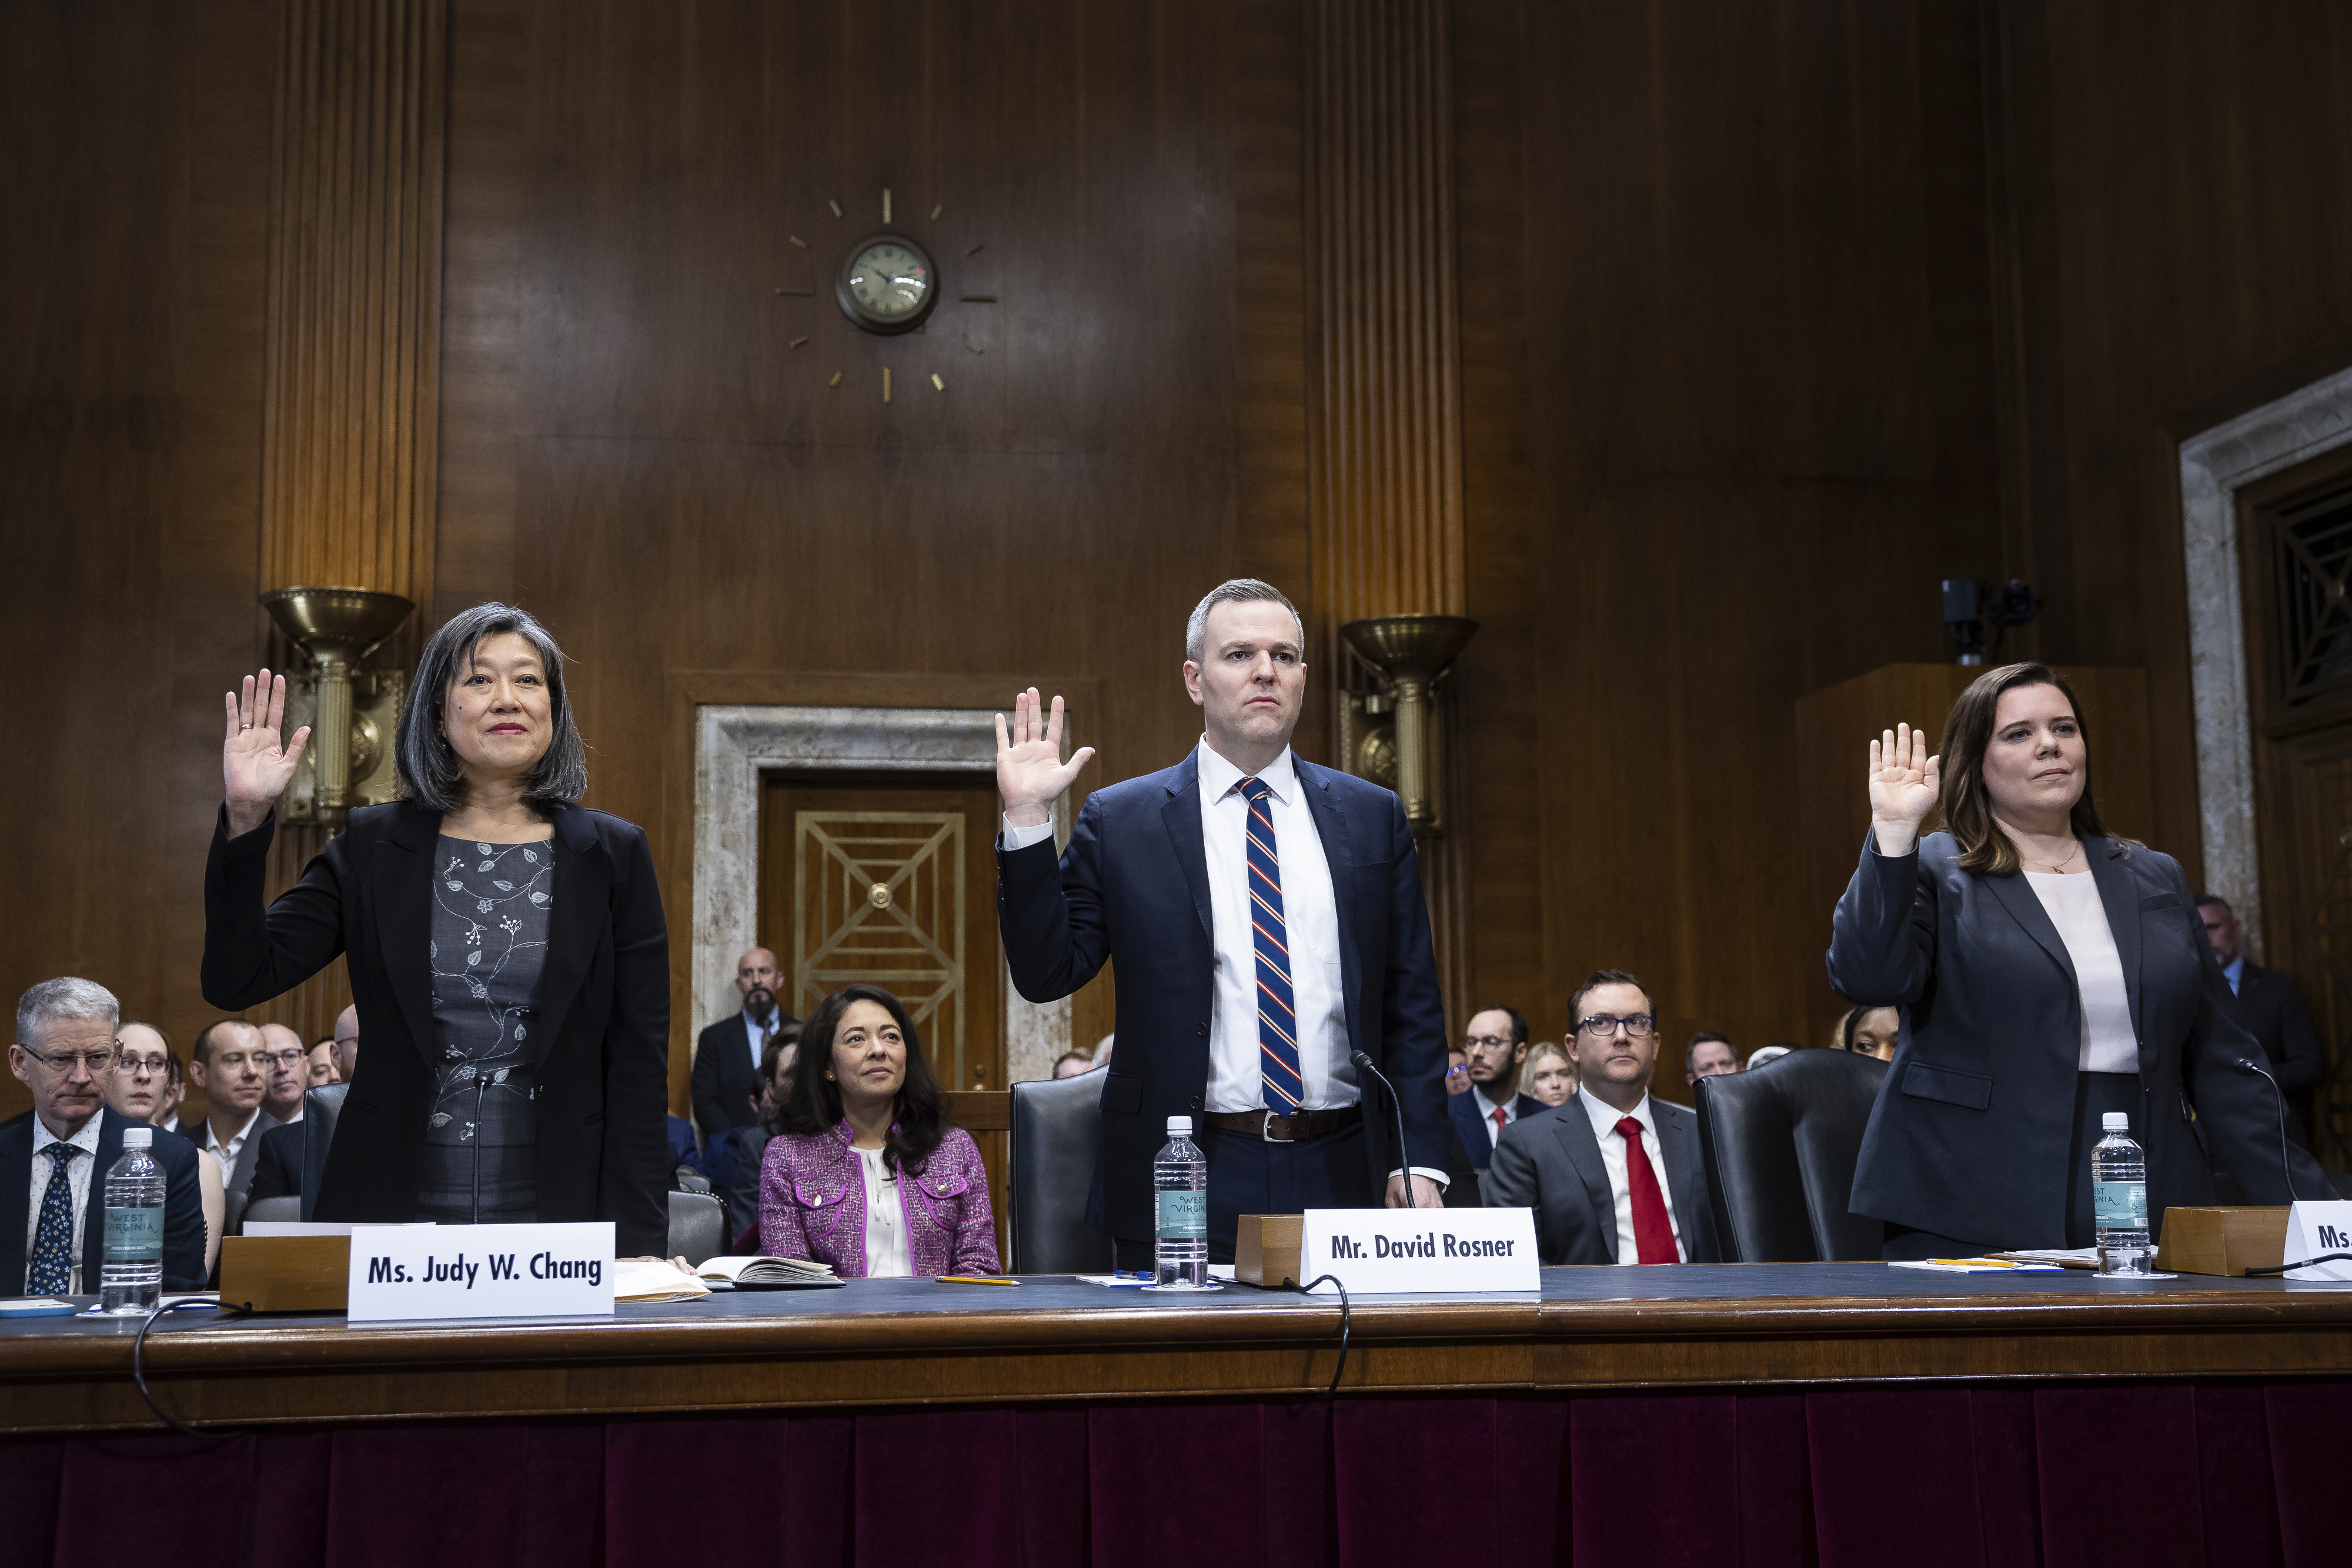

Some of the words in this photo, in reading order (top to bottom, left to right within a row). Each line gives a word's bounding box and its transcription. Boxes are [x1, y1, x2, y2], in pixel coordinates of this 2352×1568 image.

[1180, 1196, 1205, 1204] WEST
[2095, 1196, 2120, 1206] GINIA
[1171, 1204, 1205, 1215] VIRGIN
[110, 1213, 146, 1222] WEST
[106, 1222, 158, 1234] VIRGINIA
[2318, 1225, 2352, 1248] Ms
[1332, 1235, 1368, 1259] Mr.
[1375, 1232, 1436, 1258] David
[1442, 1233, 1515, 1257] Rosner
[368, 1256, 414, 1283] Ms.
[422, 1253, 479, 1290] Judy
[488, 1253, 520, 1281] W.
[530, 1251, 602, 1286] Chang
